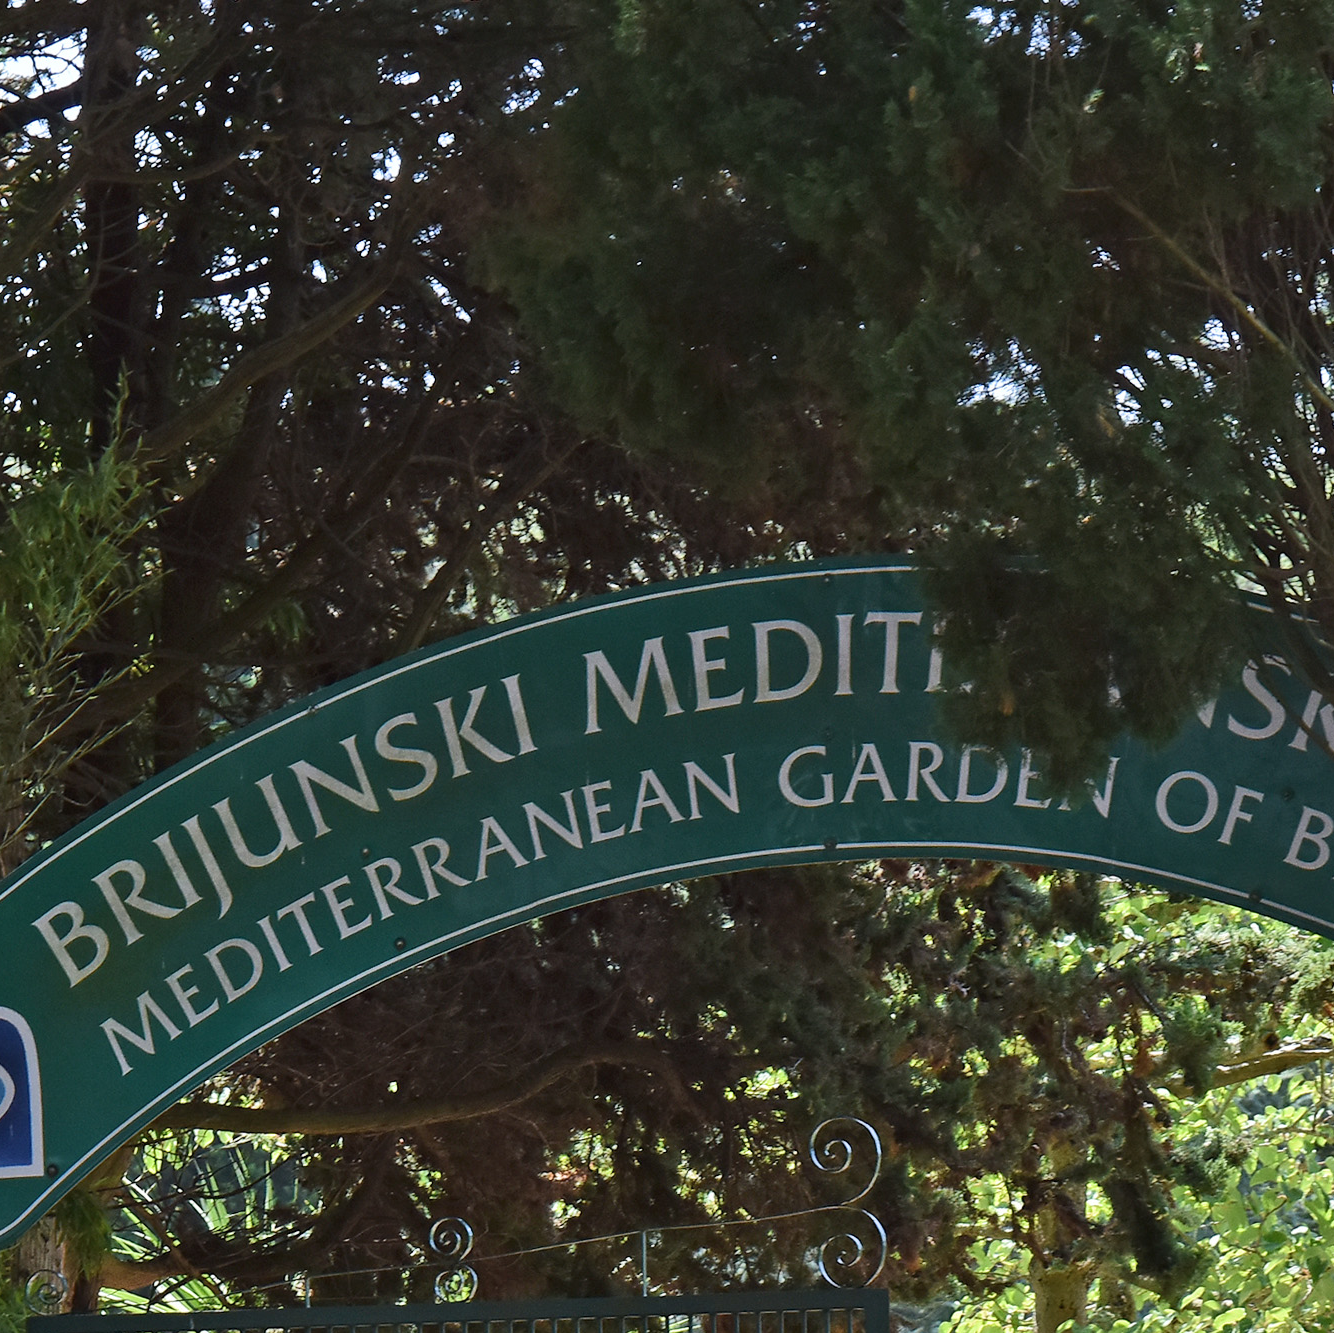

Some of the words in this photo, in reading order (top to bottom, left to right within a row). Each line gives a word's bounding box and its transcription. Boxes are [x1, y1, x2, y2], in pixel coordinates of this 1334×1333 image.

[31, 673, 539, 988] BRIJUNSKI
[98, 752, 740, 1075] MEDITERRANEAN
[1155, 770, 1264, 845] OF
